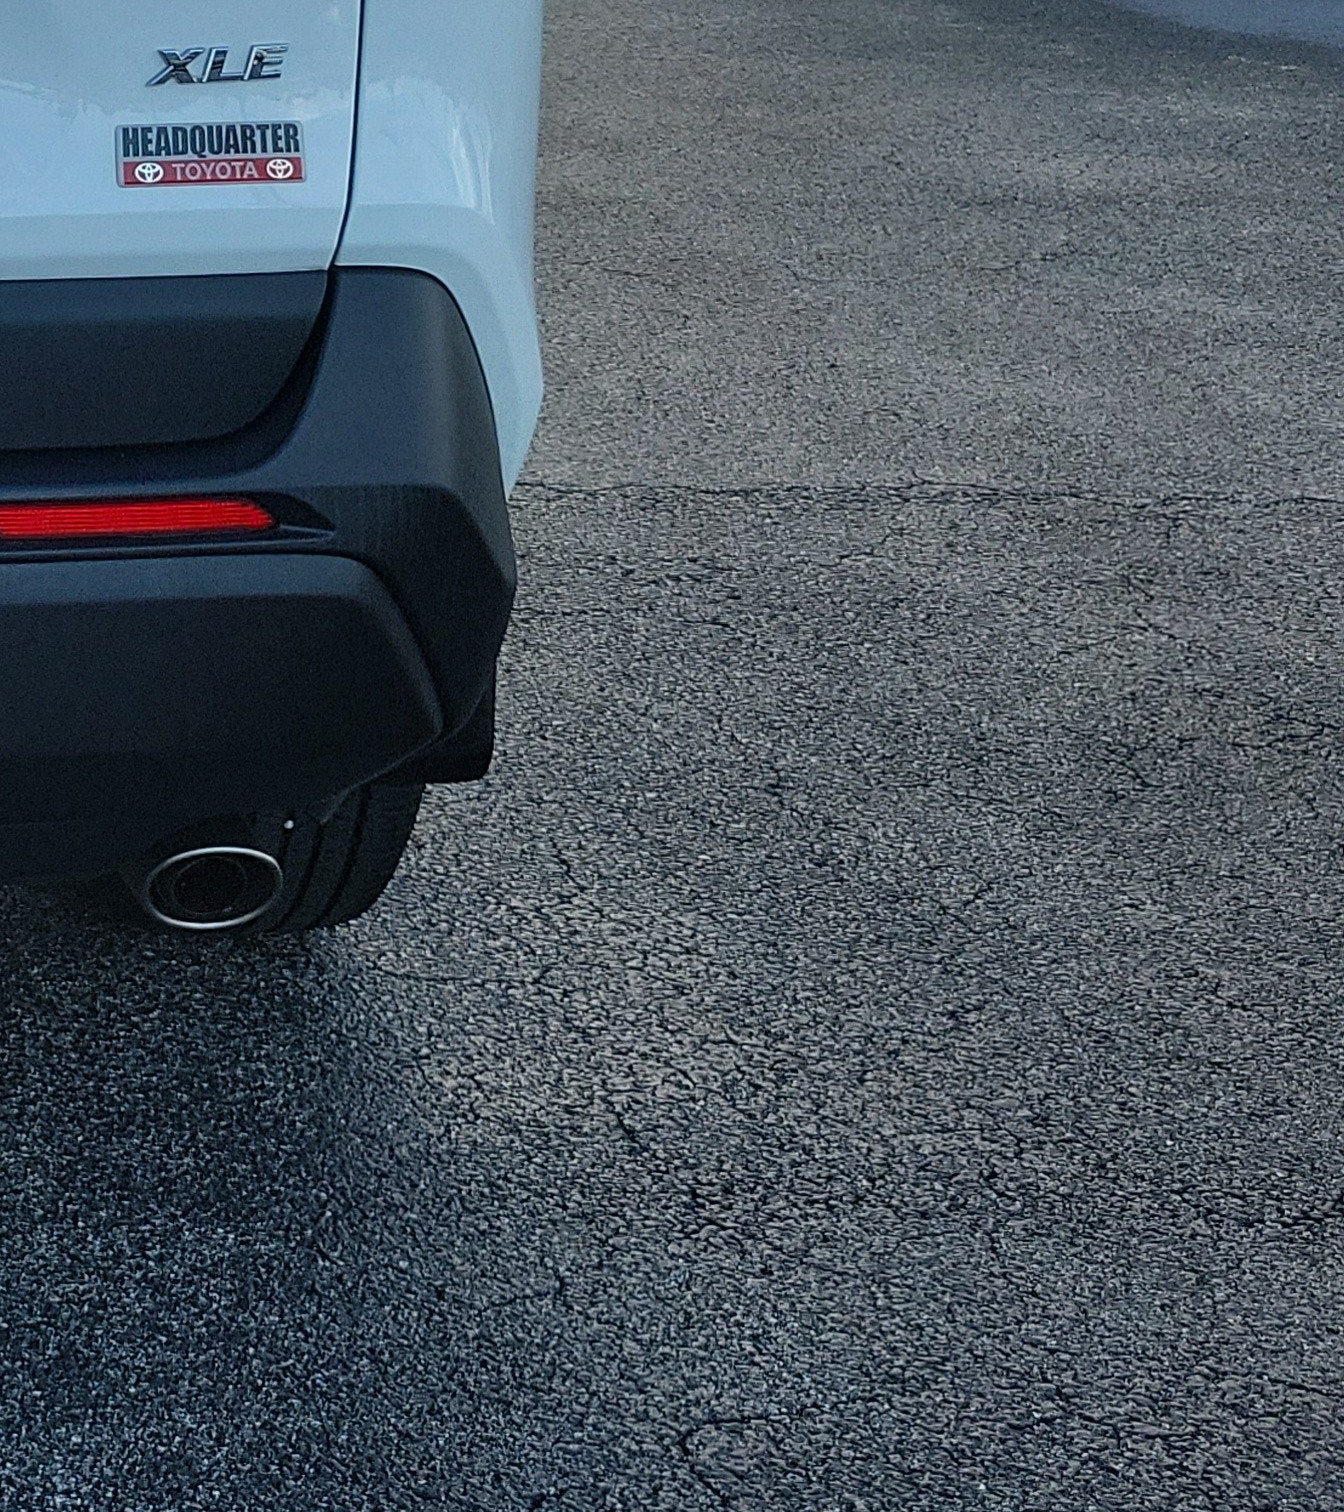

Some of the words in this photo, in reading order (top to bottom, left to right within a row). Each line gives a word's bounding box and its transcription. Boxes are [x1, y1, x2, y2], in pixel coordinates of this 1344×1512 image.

[145, 42, 290, 88] XLE
[121, 123, 300, 159] HEADQUARTER
[171, 161, 260, 181] TOYOTA
